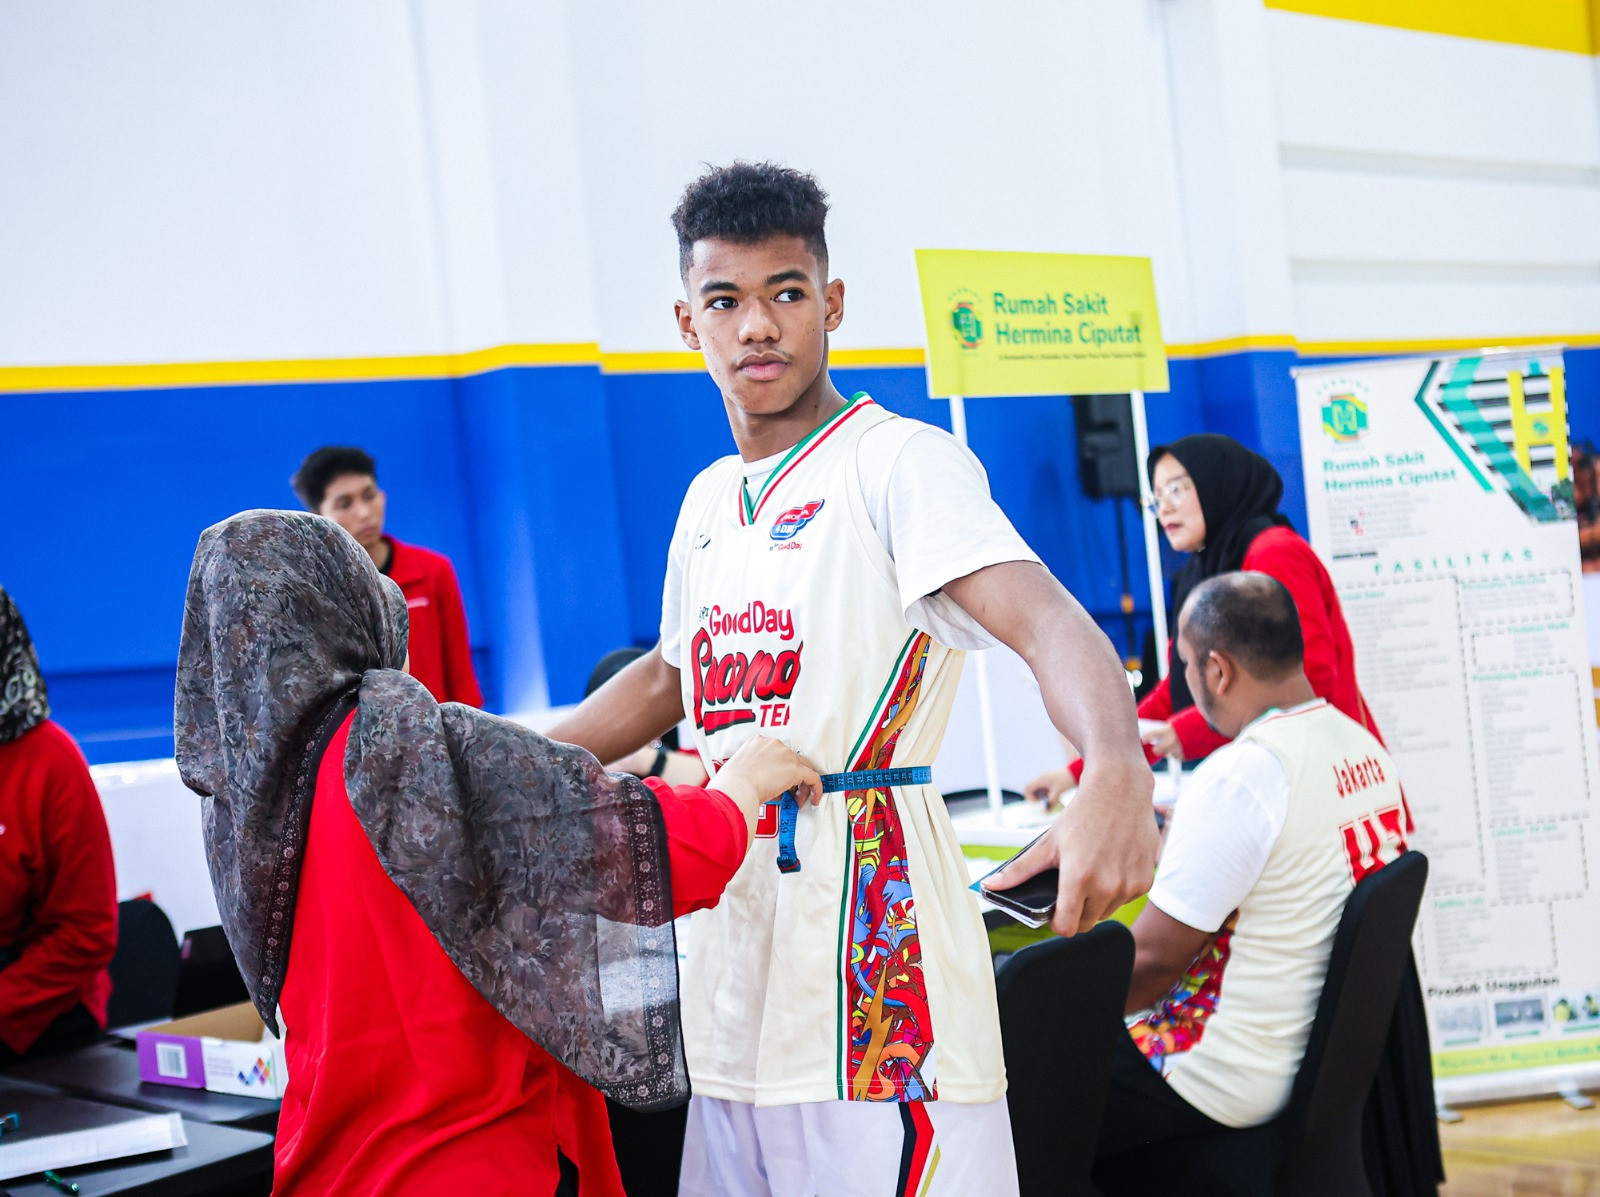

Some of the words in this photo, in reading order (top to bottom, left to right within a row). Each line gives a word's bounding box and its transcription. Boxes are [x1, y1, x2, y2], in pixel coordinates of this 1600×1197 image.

[993, 292, 1058, 315] Rumah
[1063, 292, 1109, 315] Sakit
[996, 321, 1073, 345] Hermina
[1078, 322, 1142, 349] Ciputat
[1323, 457, 1380, 473] Rumah
[1385, 453, 1426, 467] Sakit
[1325, 475, 1394, 491] Hermina
[1399, 469, 1457, 486] Ciputat
[1373, 549, 1533, 575] FASILITAS
[1332, 755, 1386, 799] Jakarta
[780, 819, 789, 834] 39
[1486, 977, 1560, 993] Unggulan
